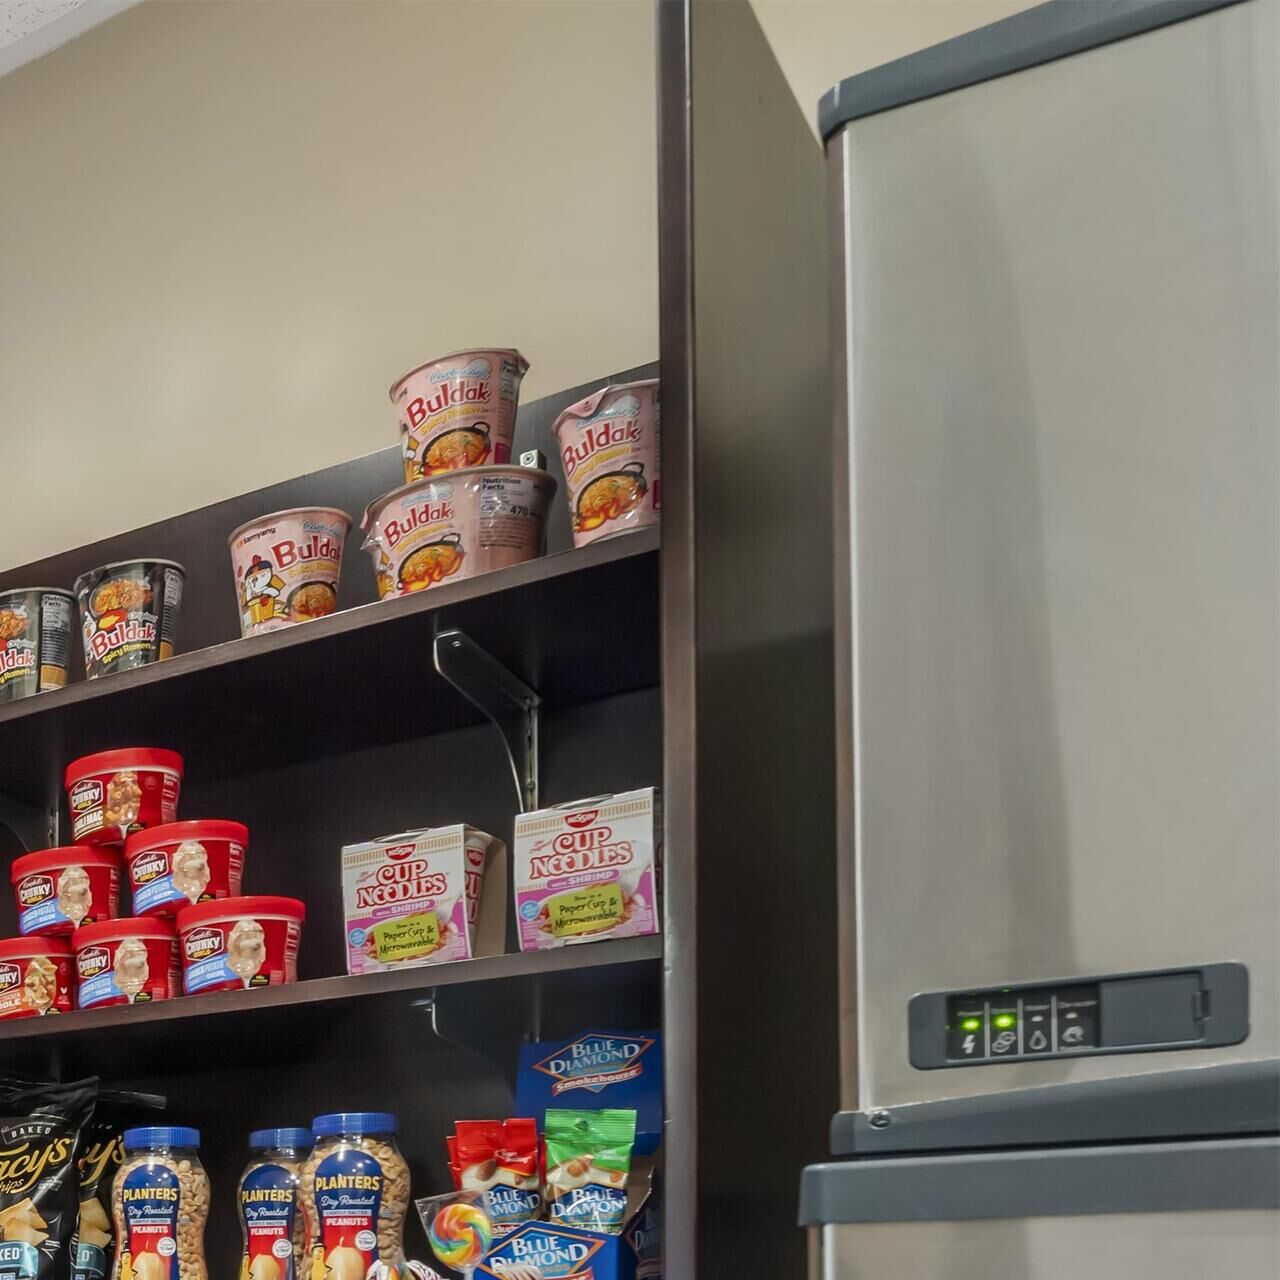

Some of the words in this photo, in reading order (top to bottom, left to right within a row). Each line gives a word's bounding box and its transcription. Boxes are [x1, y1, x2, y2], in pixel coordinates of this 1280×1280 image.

[406, 381, 491, 429] Buldak
[562, 420, 640, 475] Buldak
[383, 502, 453, 549] Buldak
[90, 622, 156, 660] Buldak
[554, 826, 612, 854] CUP
[531, 843, 633, 880] NOODLES
[377, 859, 428, 884] CUP
[568, 871, 613, 885] SHRIMP
[357, 873, 447, 908] NOODLES
[390, 901, 430, 913] SHRIMP
[571, 1040, 616, 1057] BLUE
[550, 1043, 640, 1075] DIAMOND
[556, 1069, 638, 1093] Smokehouse
[11, 1126, 52, 1137] BAKED
[315, 1176, 380, 1191] PLANTERS
[123, 1188, 178, 1201] PLANTERS
[242, 1190, 293, 1203] PLANTERS
[321, 1196, 337, 1207] Dry
[338, 1195, 375, 1206] Roasted
[551, 1192, 624, 1216] DIAMOND
[571, 1188, 615, 1204] BLUE
[128, 1207, 142, 1217] Dry
[143, 1205, 174, 1215] Roasted
[132, 1225, 169, 1234] PEANUTS
[326, 1217, 368, 1227] PEANUTS
[512, 1236, 558, 1257] BLUE
